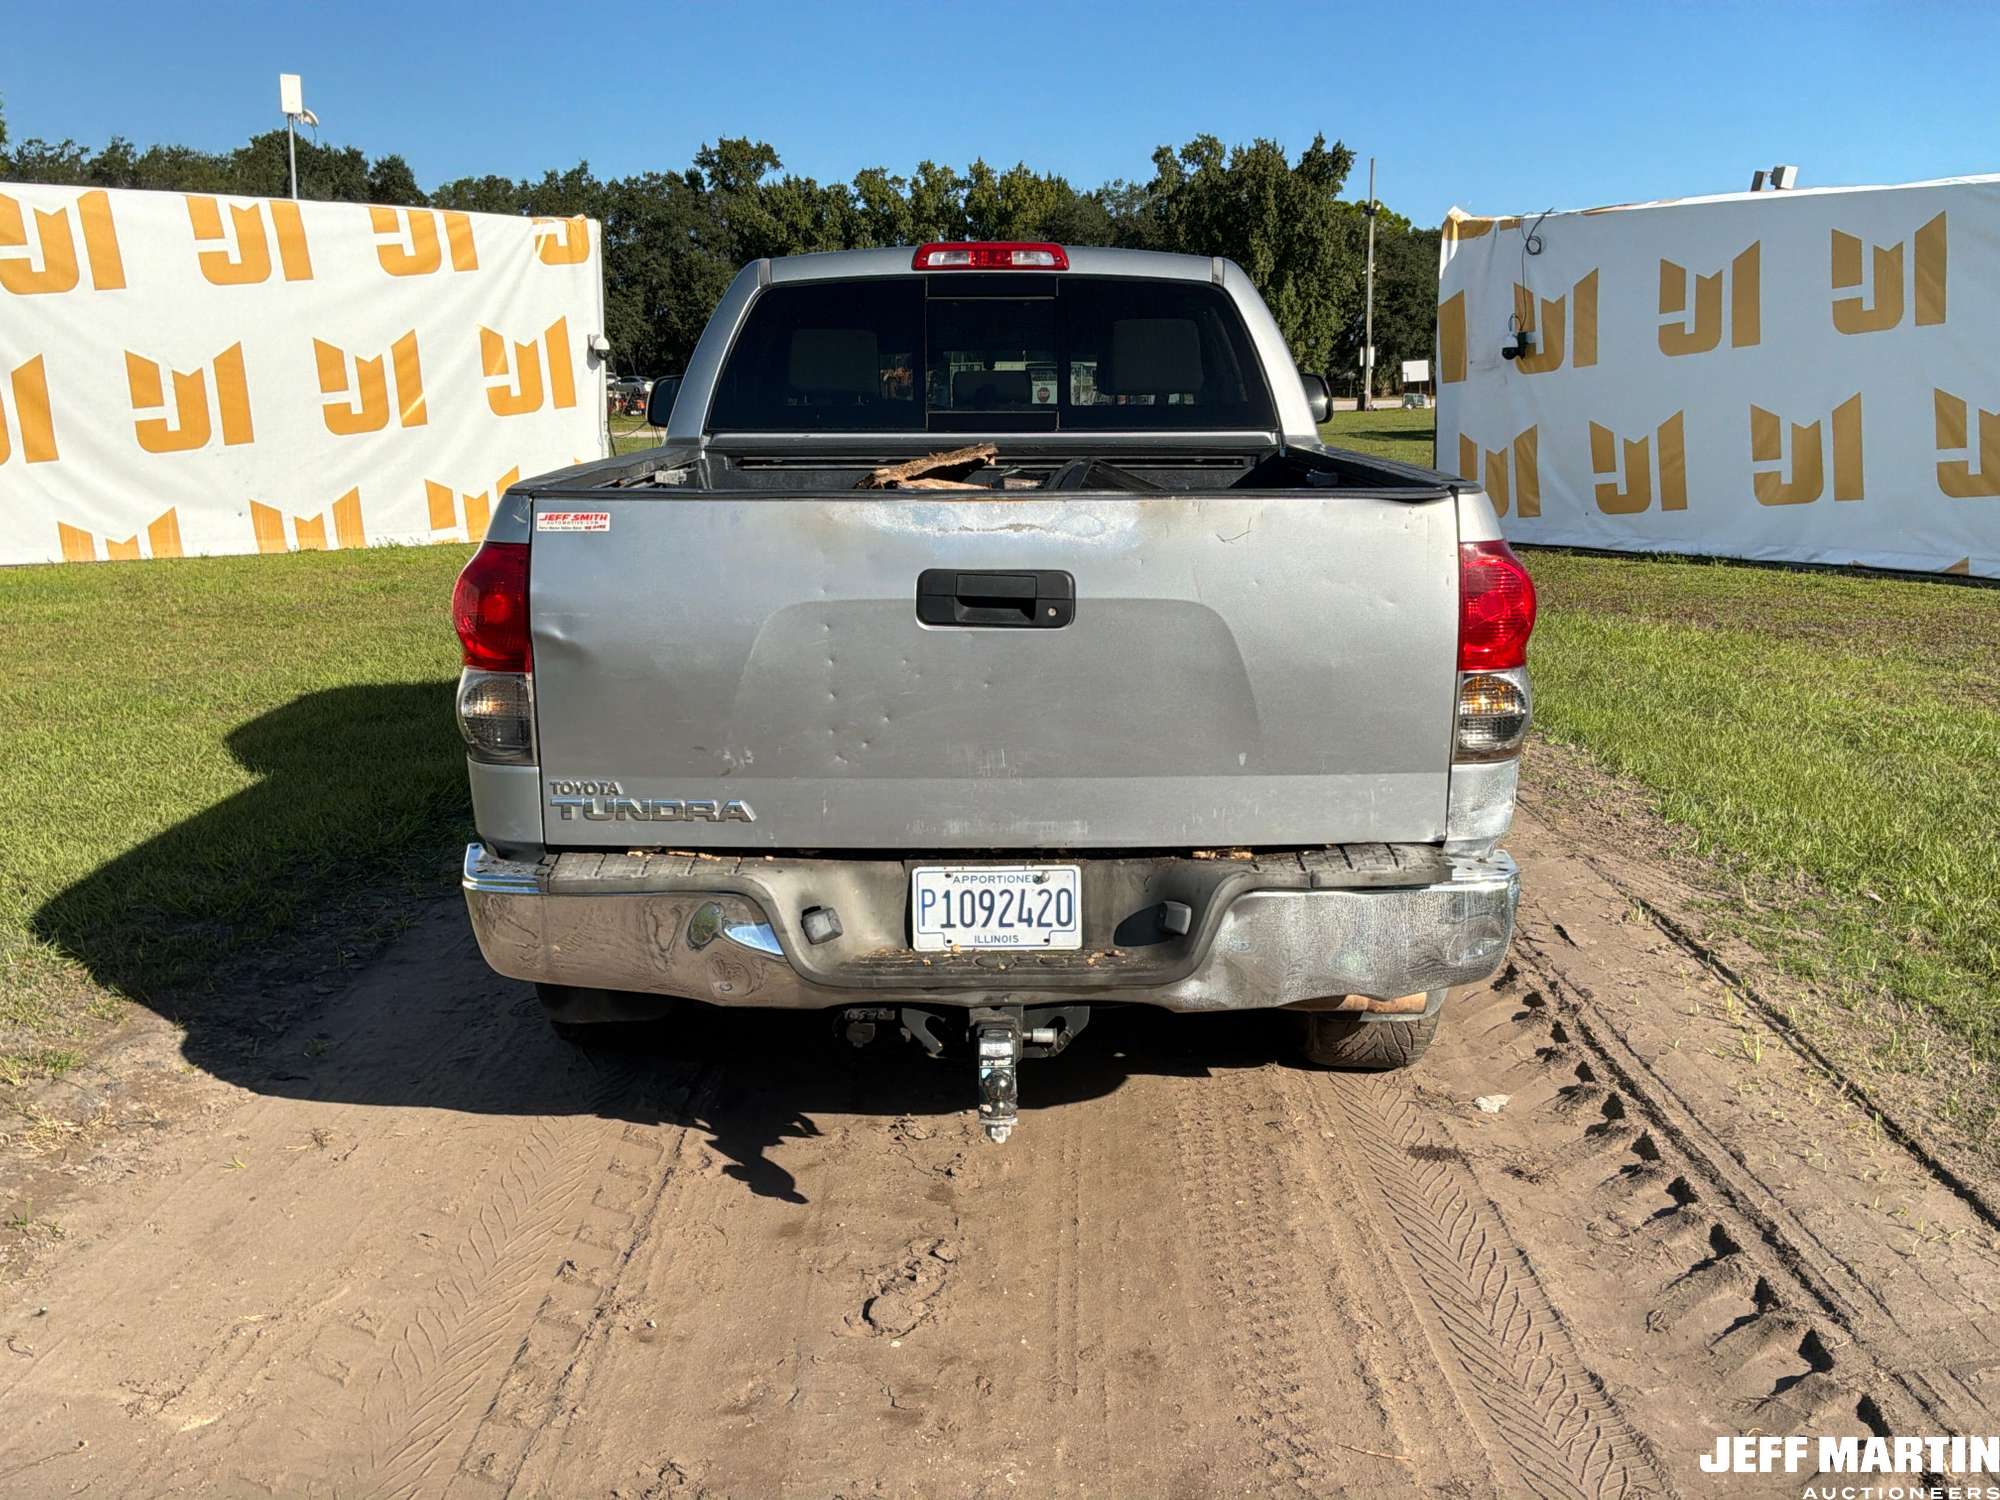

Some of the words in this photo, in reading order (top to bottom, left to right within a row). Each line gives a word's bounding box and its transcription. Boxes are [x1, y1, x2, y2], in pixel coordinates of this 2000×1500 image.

[539, 513, 571, 521] JEFF
[572, 513, 608, 521] SMITH
[550, 781, 623, 796] TOYOTA
[550, 799, 757, 823] TUNDRA
[921, 888, 1073, 928] P1092420
[974, 934, 1019, 944] ILLINOIS
